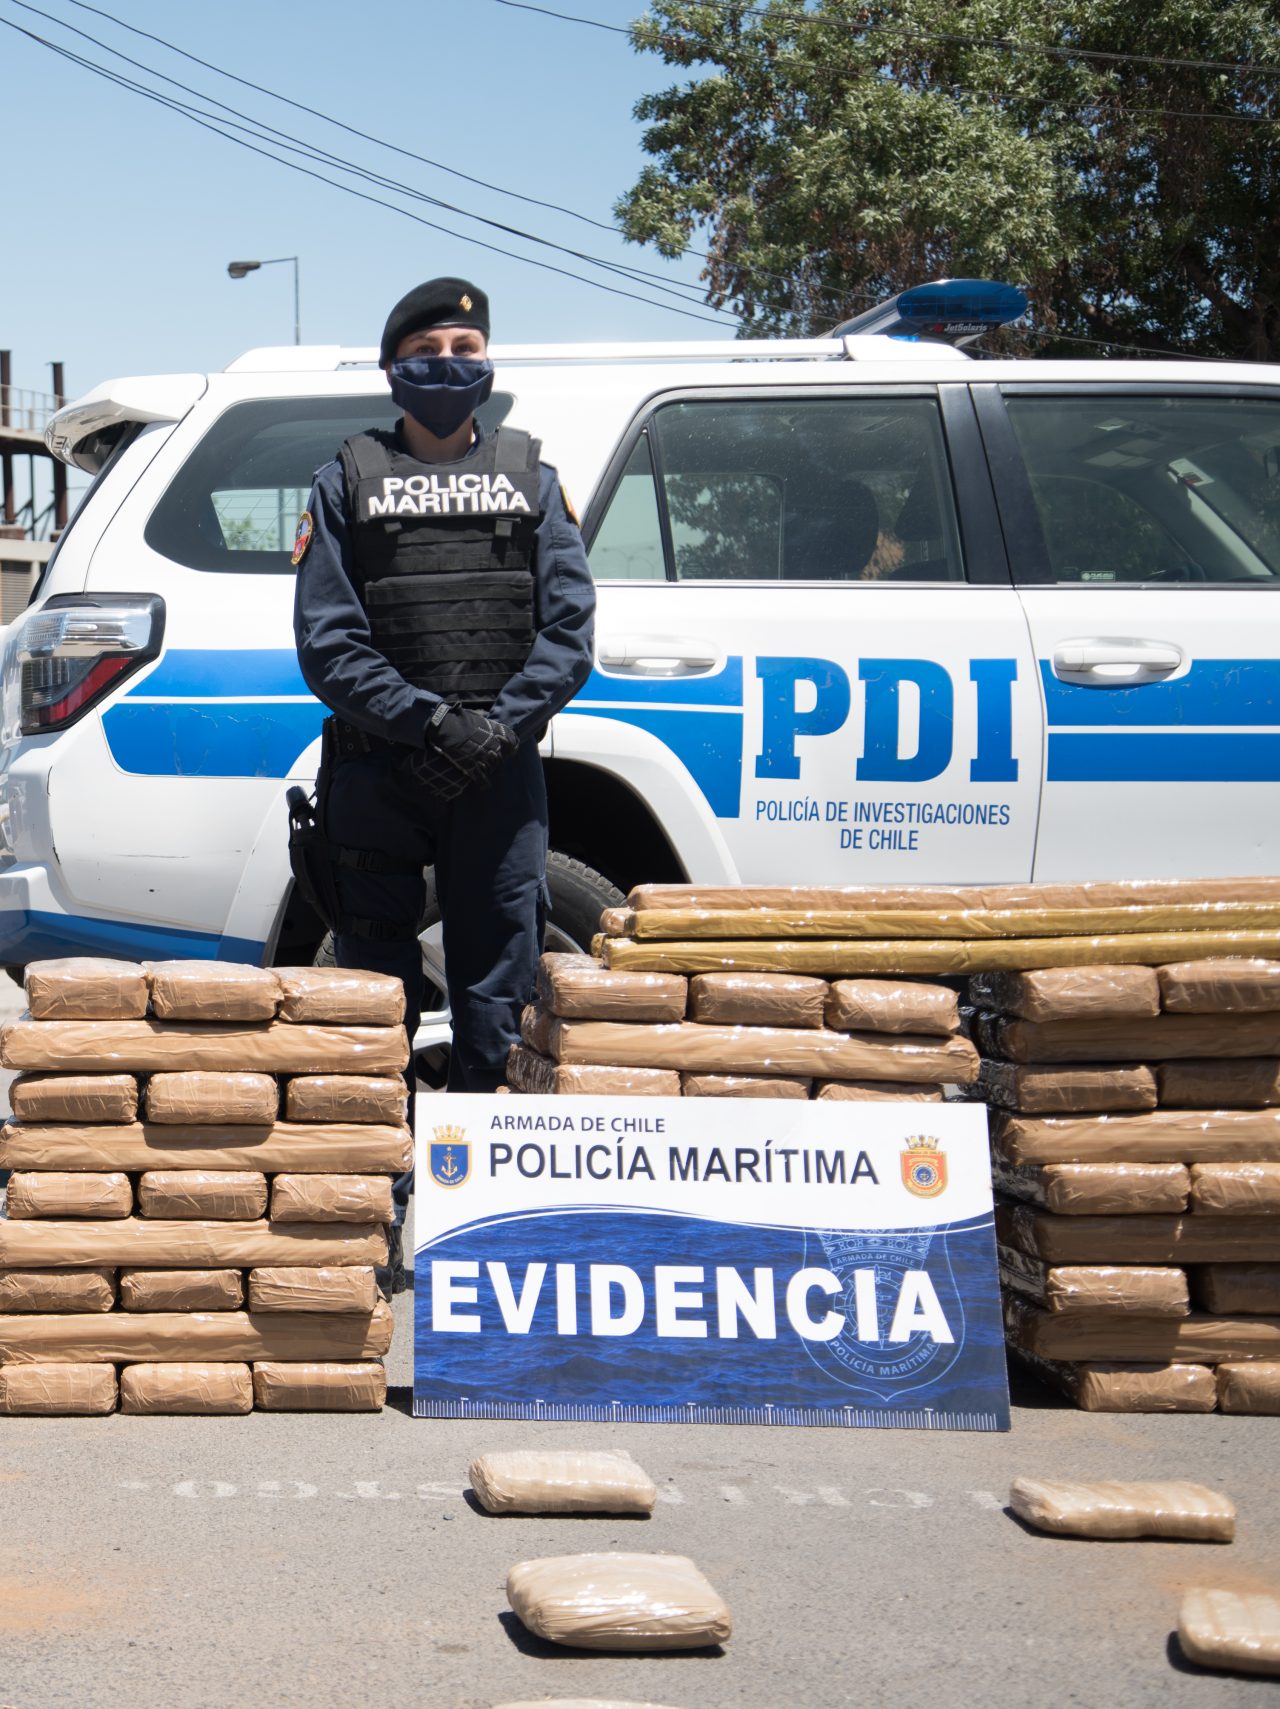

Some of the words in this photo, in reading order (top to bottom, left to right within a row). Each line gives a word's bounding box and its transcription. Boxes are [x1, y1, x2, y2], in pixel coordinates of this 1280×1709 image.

[383, 474, 515, 495] POLICIA
[755, 656, 1019, 782] PDI
[755, 796, 820, 822] POLICÍA
[825, 801, 849, 822] DE
[853, 801, 1011, 825] INVESTIGACIONES
[840, 829, 863, 849] DE
[868, 829, 919, 850] CHILE
[490, 1115, 577, 1133] ARMADA
[581, 1116, 606, 1133] DE
[611, 1117, 666, 1134] CHILE
[488, 1137, 654, 1181] POLICÍA
[668, 1140, 880, 1185] MARÍTIMA
[836, 1253, 872, 1265] ARMADA
[875, 1253, 888, 1261] DE
[889, 1254, 915, 1266] CHILE
[431, 1260, 956, 1344] EVIDENCIA
[830, 1340, 874, 1374] POLICÍA
[879, 1342, 937, 1376] MARÍTIMA
